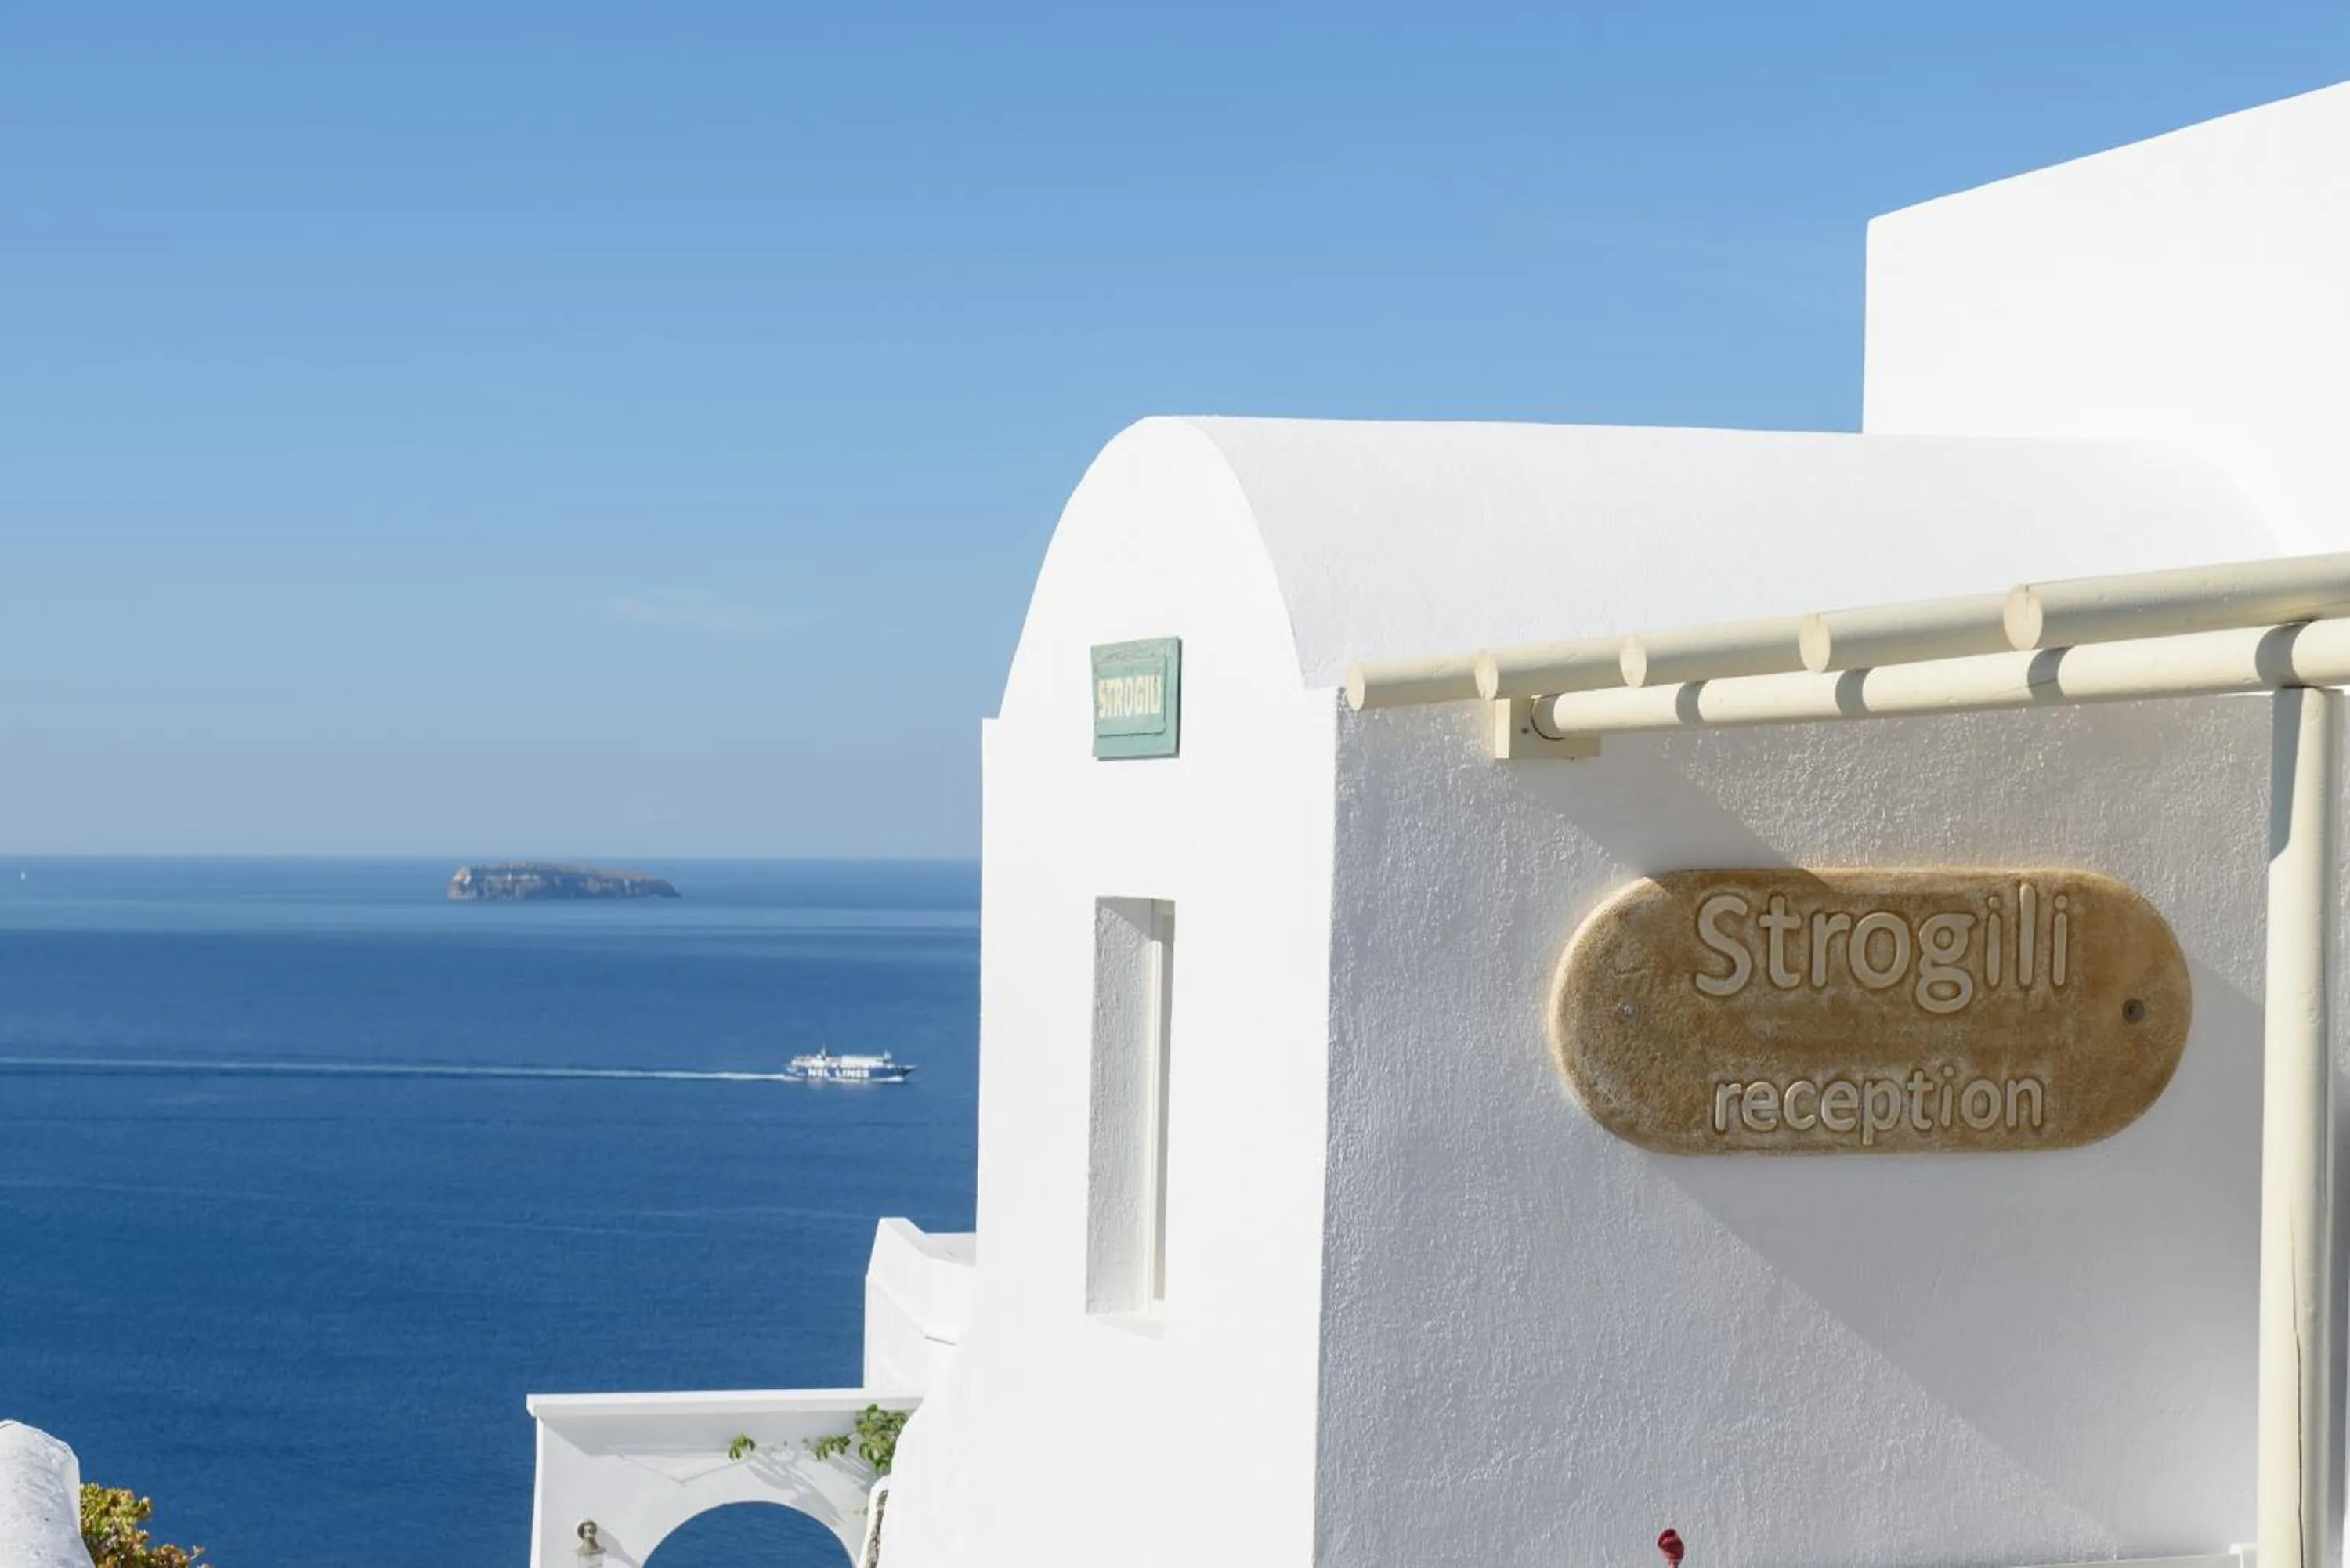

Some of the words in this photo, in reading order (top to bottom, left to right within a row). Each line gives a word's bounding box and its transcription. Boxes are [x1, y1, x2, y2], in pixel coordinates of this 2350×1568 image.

[1694, 882, 2070, 1013] Strogili
[835, 1068, 870, 1078] LINES
[1713, 1066, 2044, 1146] reception
